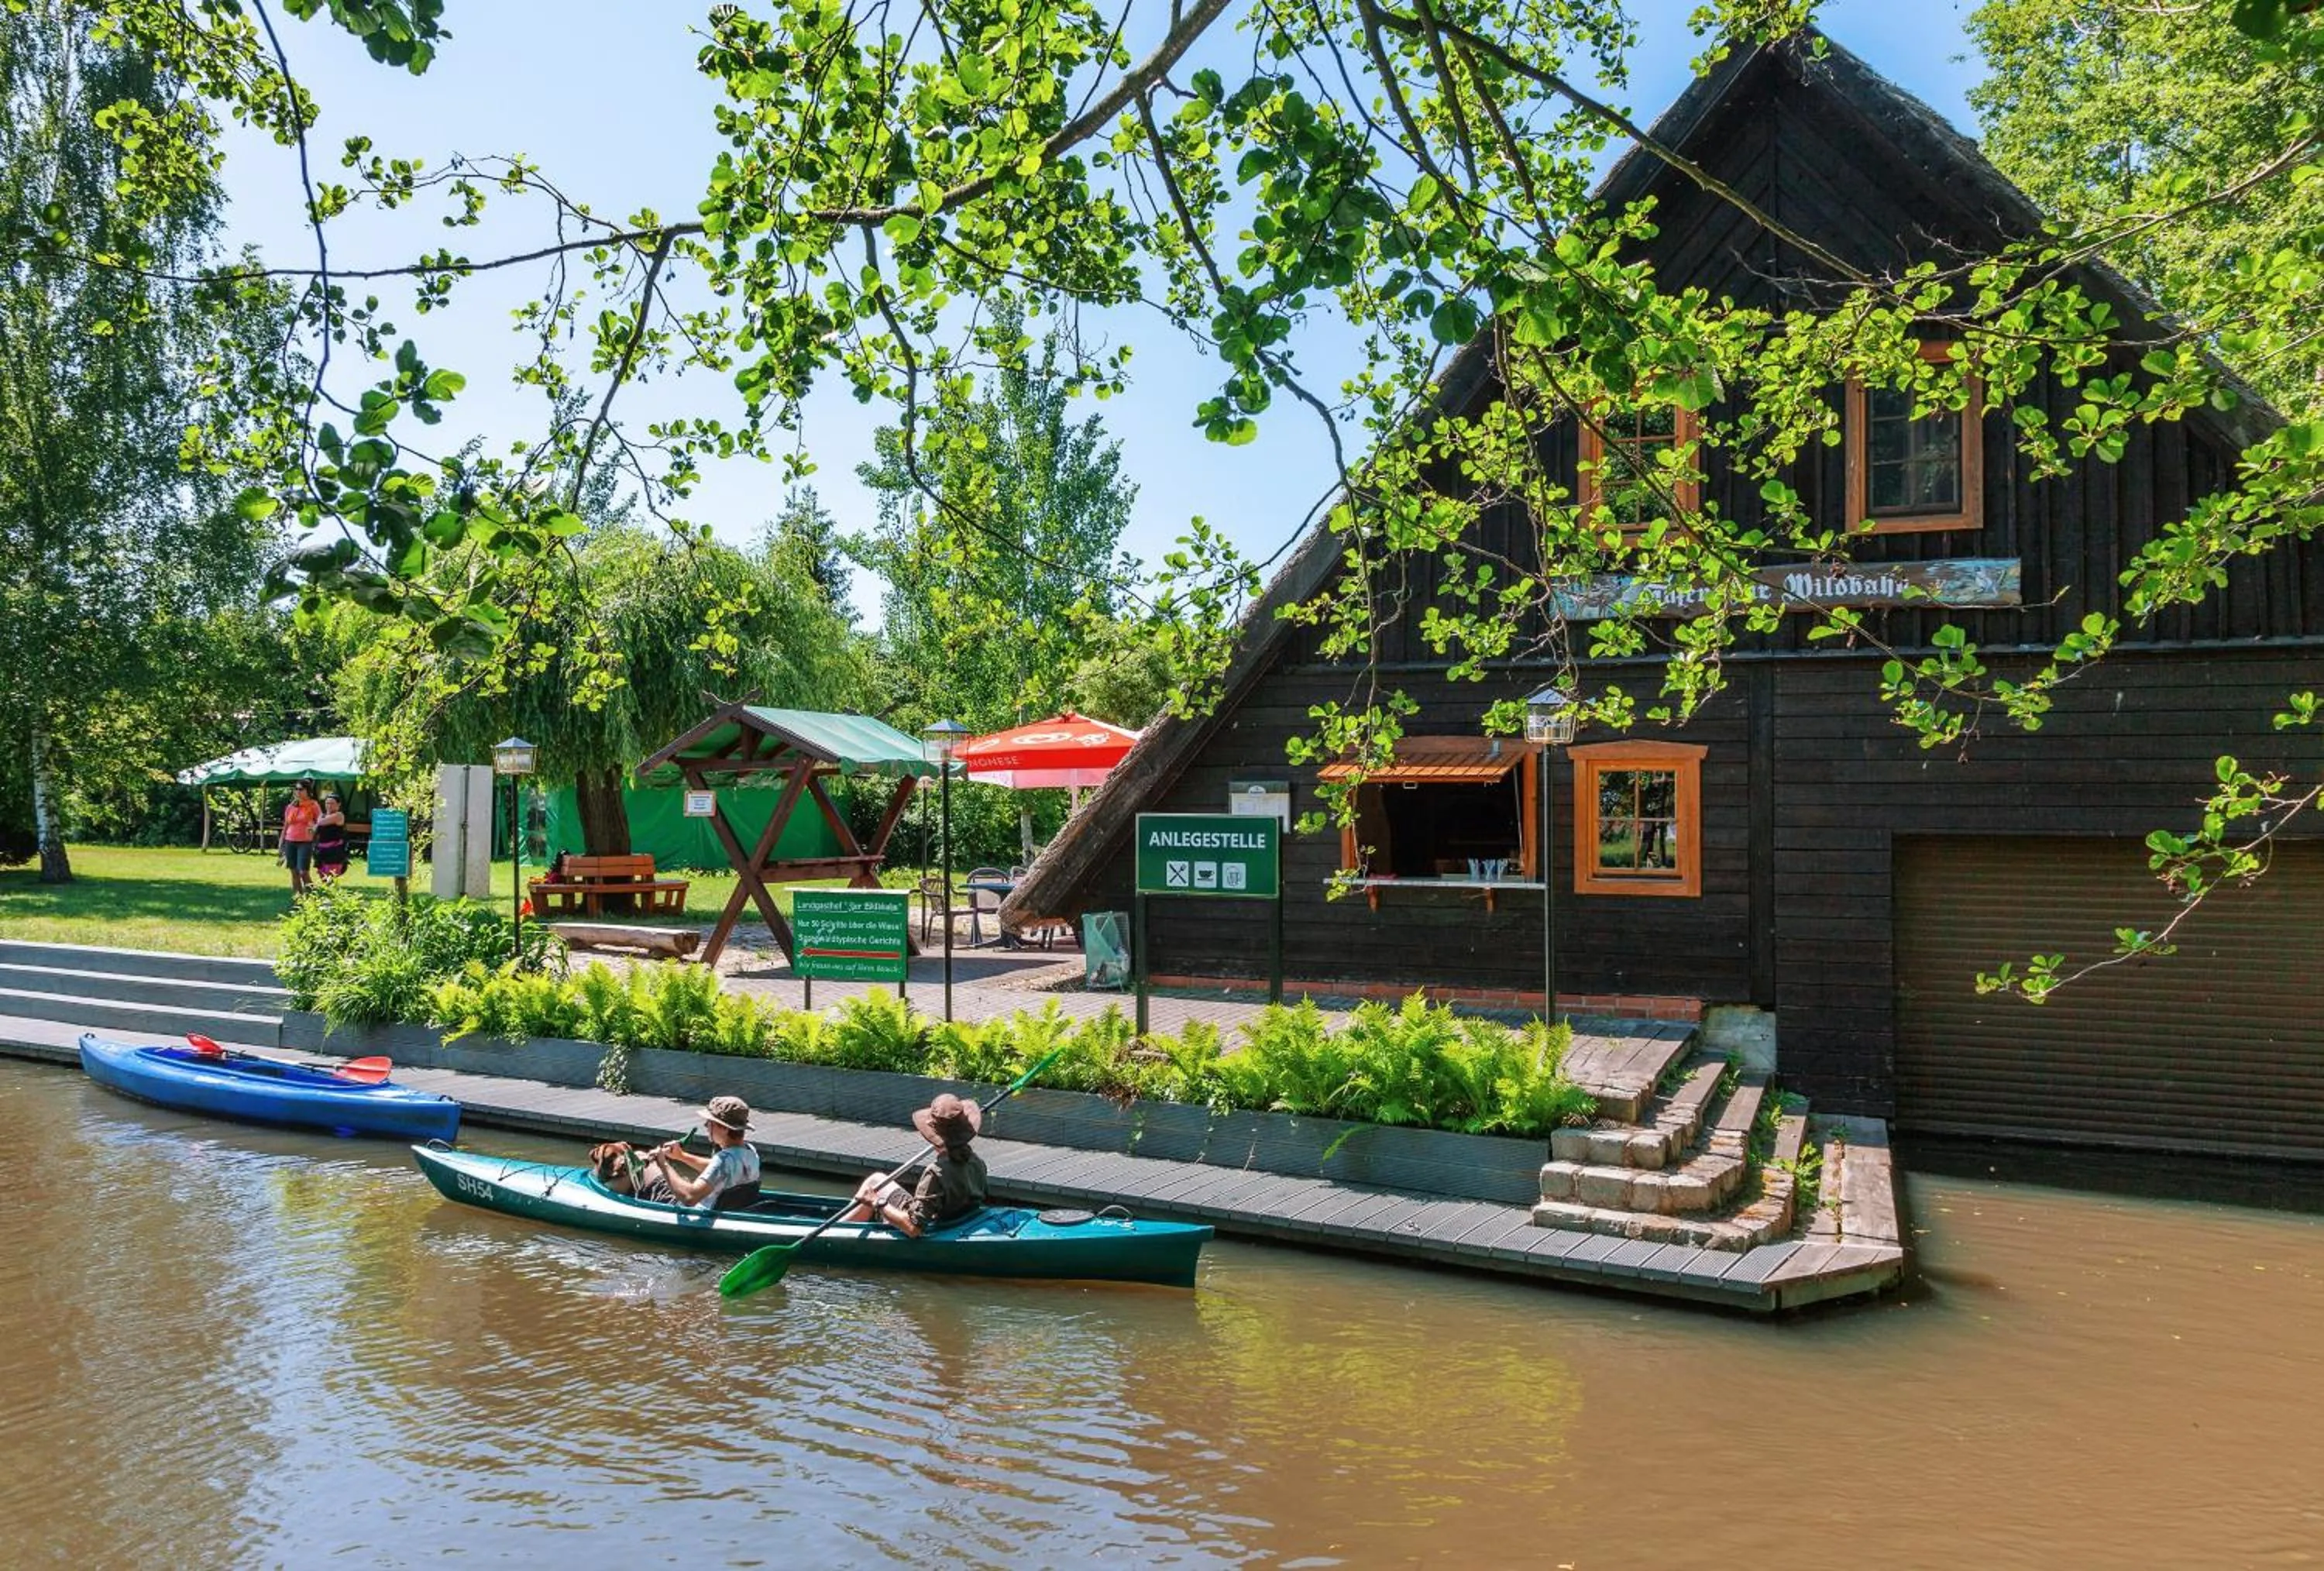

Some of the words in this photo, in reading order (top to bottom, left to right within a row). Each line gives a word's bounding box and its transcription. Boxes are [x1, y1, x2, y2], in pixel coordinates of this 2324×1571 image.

[1149, 830, 1267, 849] ANLEGESTELLE
[796, 919, 810, 928] Nur
[456, 1173, 494, 1201] SH54
